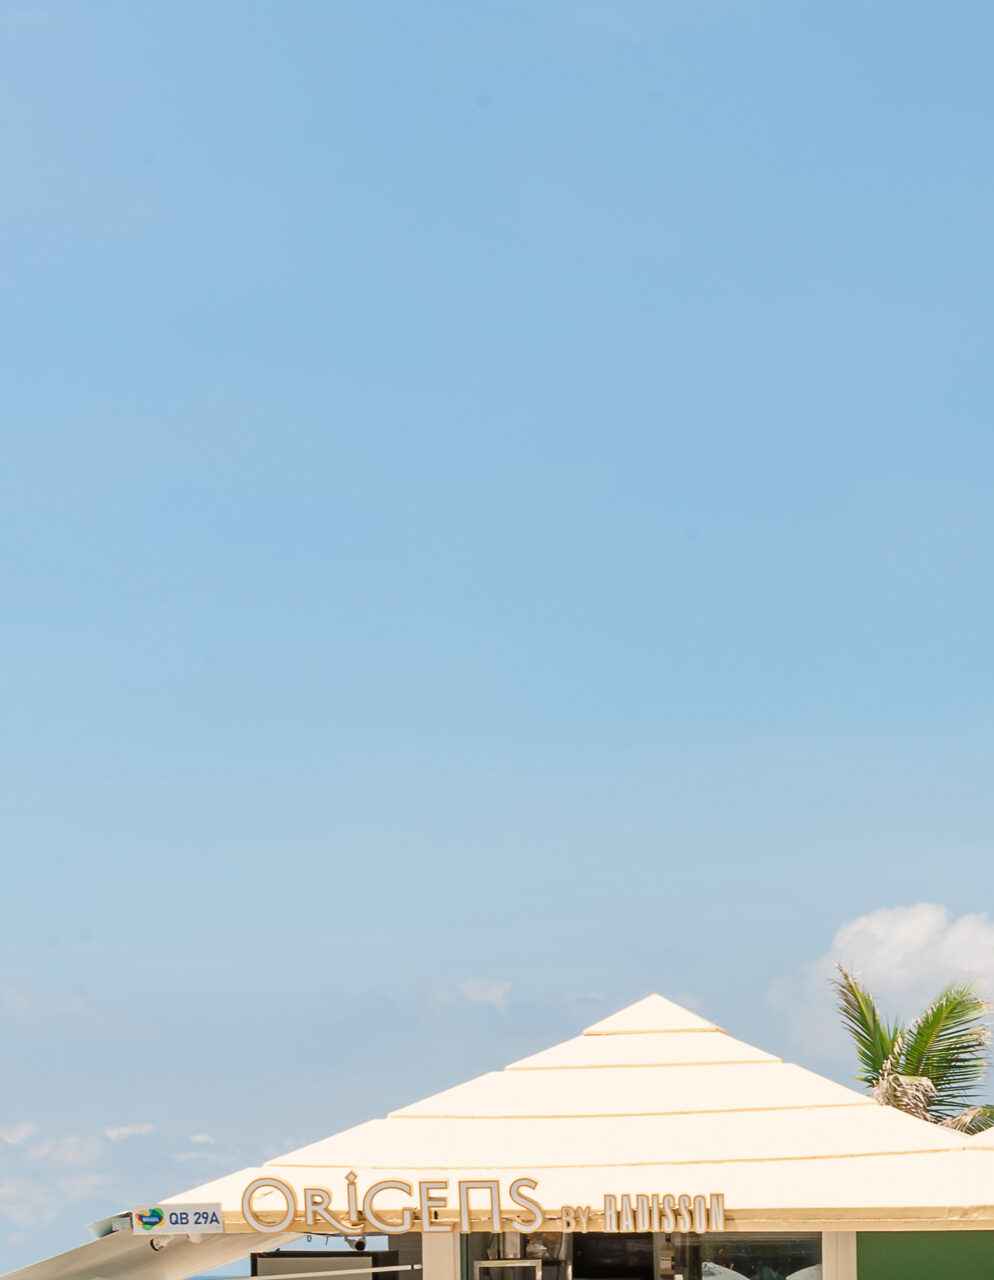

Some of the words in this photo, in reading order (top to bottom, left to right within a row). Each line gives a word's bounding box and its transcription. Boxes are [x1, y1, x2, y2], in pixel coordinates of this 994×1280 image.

[169, 1212, 190, 1225] QB
[193, 1211, 220, 1225] 29A
[561, 1205, 592, 1233] BY
[604, 1193, 724, 1234] RADISSON
